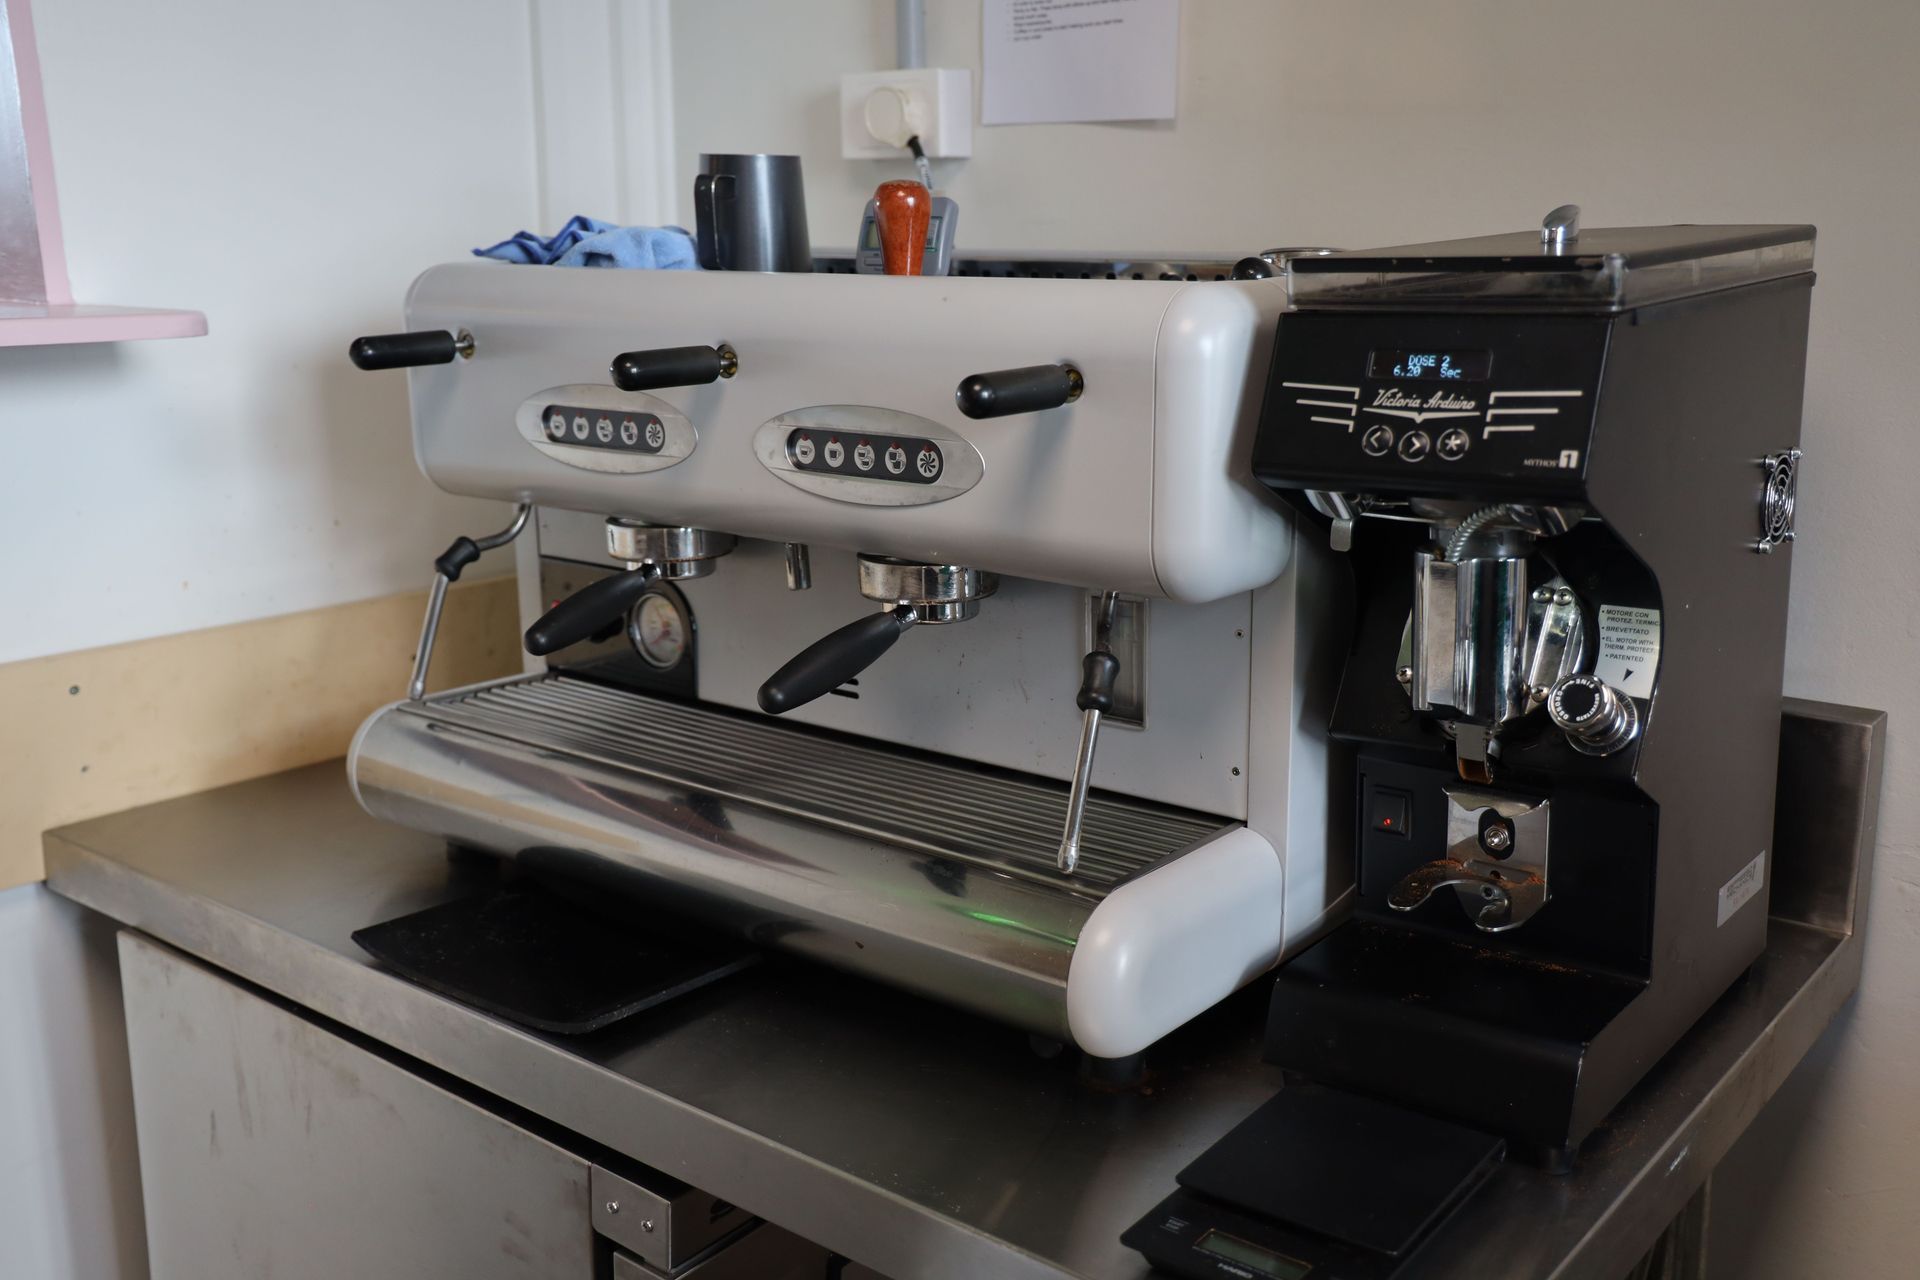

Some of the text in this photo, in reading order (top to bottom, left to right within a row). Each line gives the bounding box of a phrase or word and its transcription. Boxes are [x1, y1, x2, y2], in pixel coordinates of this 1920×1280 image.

[1408, 355, 1450, 367] DOSE 2
[1393, 365, 1461, 378] 6.20 Sec
[1372, 388, 1476, 410] Victoria Arduino
[1606, 609, 1633, 617] MOTORE
[1605, 626, 1650, 635] BREVETTATO
[1609, 653, 1644, 662] PATENTED
[1575, 678, 1595, 689] FINE
